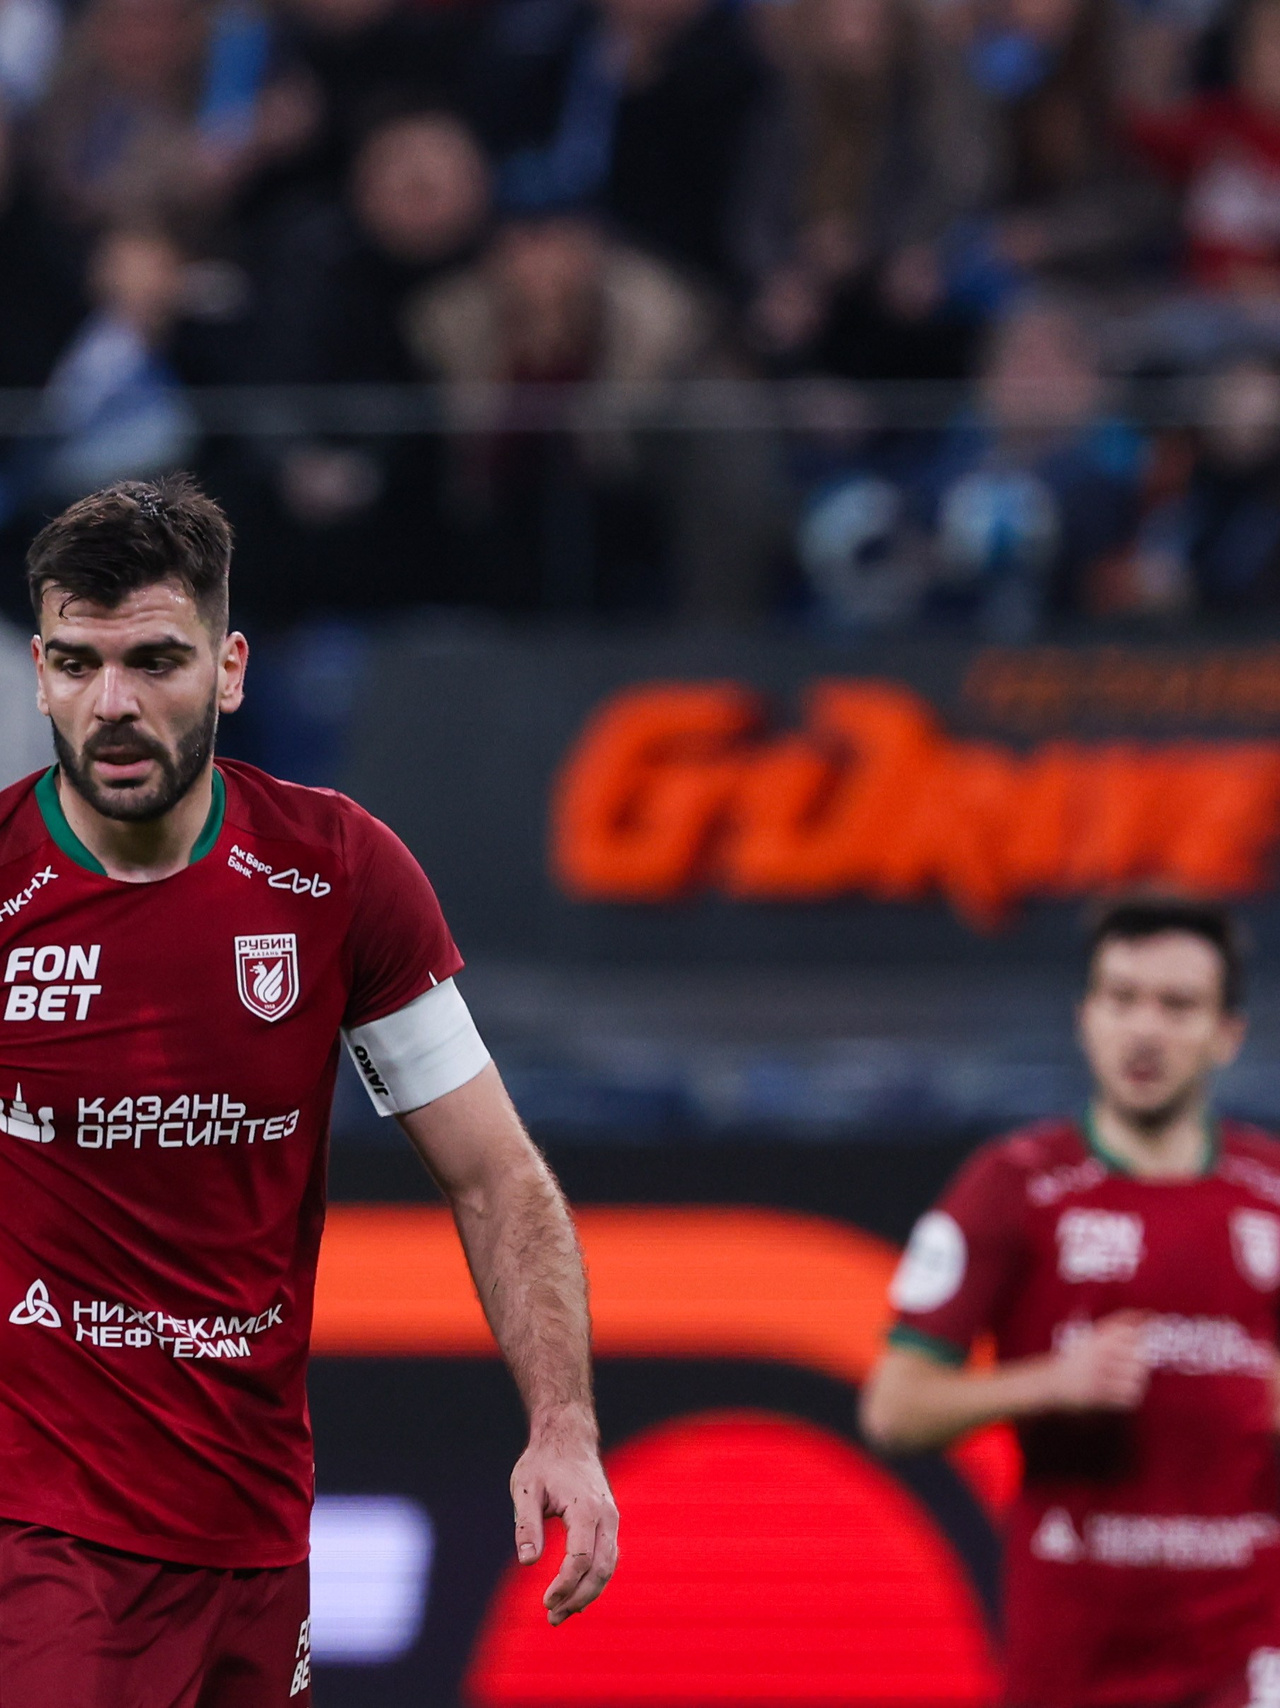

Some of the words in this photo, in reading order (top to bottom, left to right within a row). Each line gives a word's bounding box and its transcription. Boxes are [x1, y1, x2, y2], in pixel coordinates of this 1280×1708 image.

[227, 855, 253, 879] Банк
[230, 844, 246, 860] Ак
[245, 852, 273, 875] Барс
[238, 938, 293, 951] РУБИН
[4, 944, 101, 983] FON
[3, 984, 102, 1021] BET
[354, 1045, 389, 1096] JAKO
[77, 1093, 246, 1123] КАЗАНЬ
[77, 1109, 300, 1149] ОРГСИНТЕЗ
[73, 1301, 283, 1339] НИЖНЕКАМСК
[75, 1322, 251, 1358] НЕФТЕХИМ
[289, 1653, 311, 1698] BE
